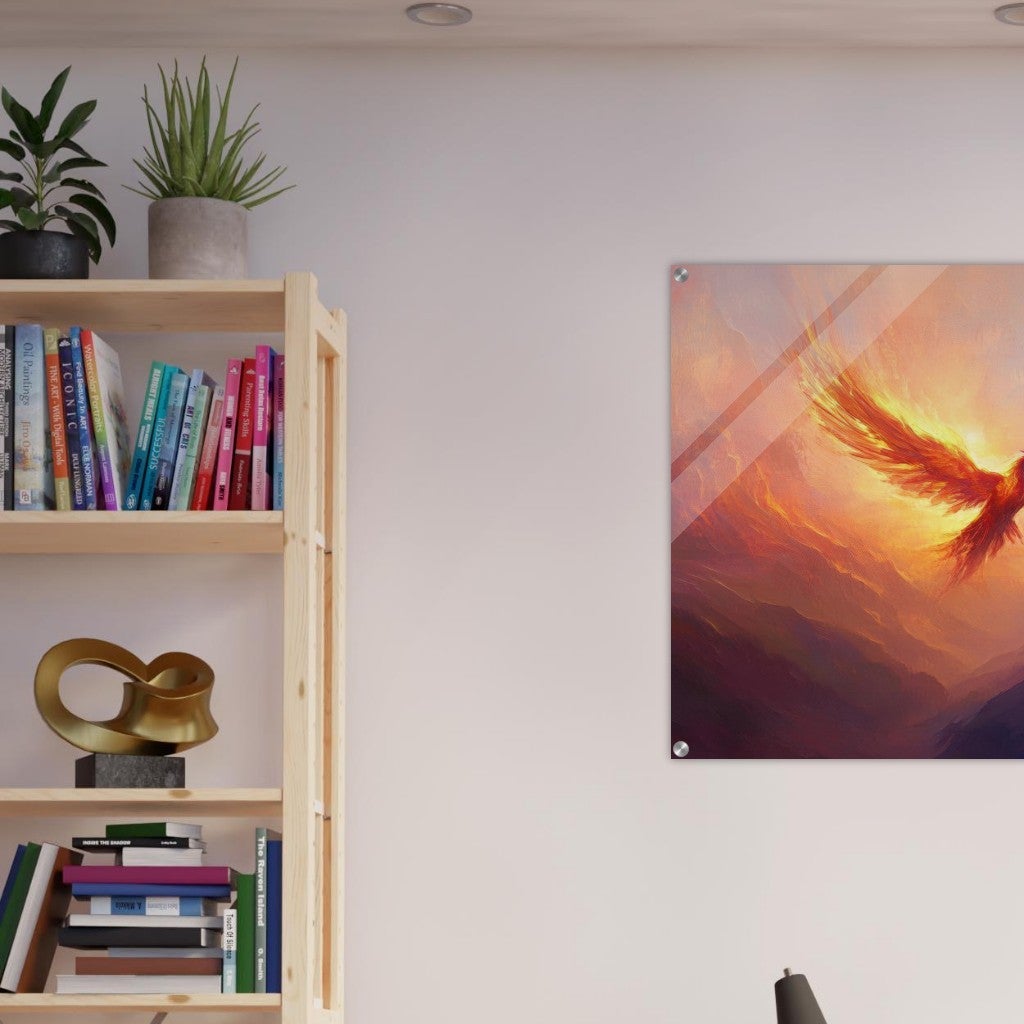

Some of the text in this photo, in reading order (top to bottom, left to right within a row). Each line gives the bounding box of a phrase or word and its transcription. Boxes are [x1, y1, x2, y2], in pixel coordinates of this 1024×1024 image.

[19, 342, 33, 405] Oil Paintings
[48, 365, 57, 383] FINE
[50, 385, 58, 399] ART
[77, 378, 85, 404] Beauty
[83, 344, 102, 432] Watercolor Portraits
[52, 404, 60, 422] With
[185, 405, 194, 417] ART
[240, 382, 253, 437] Parenting Skills
[19, 420, 30, 437] Jiro
[52, 423, 62, 447] Digital
[149, 417, 170, 468] SUCCESSFUL
[55, 448, 64, 465] Tools
[83, 464, 93, 496] NORMAN
[257, 836, 265, 926] The Raven Island
